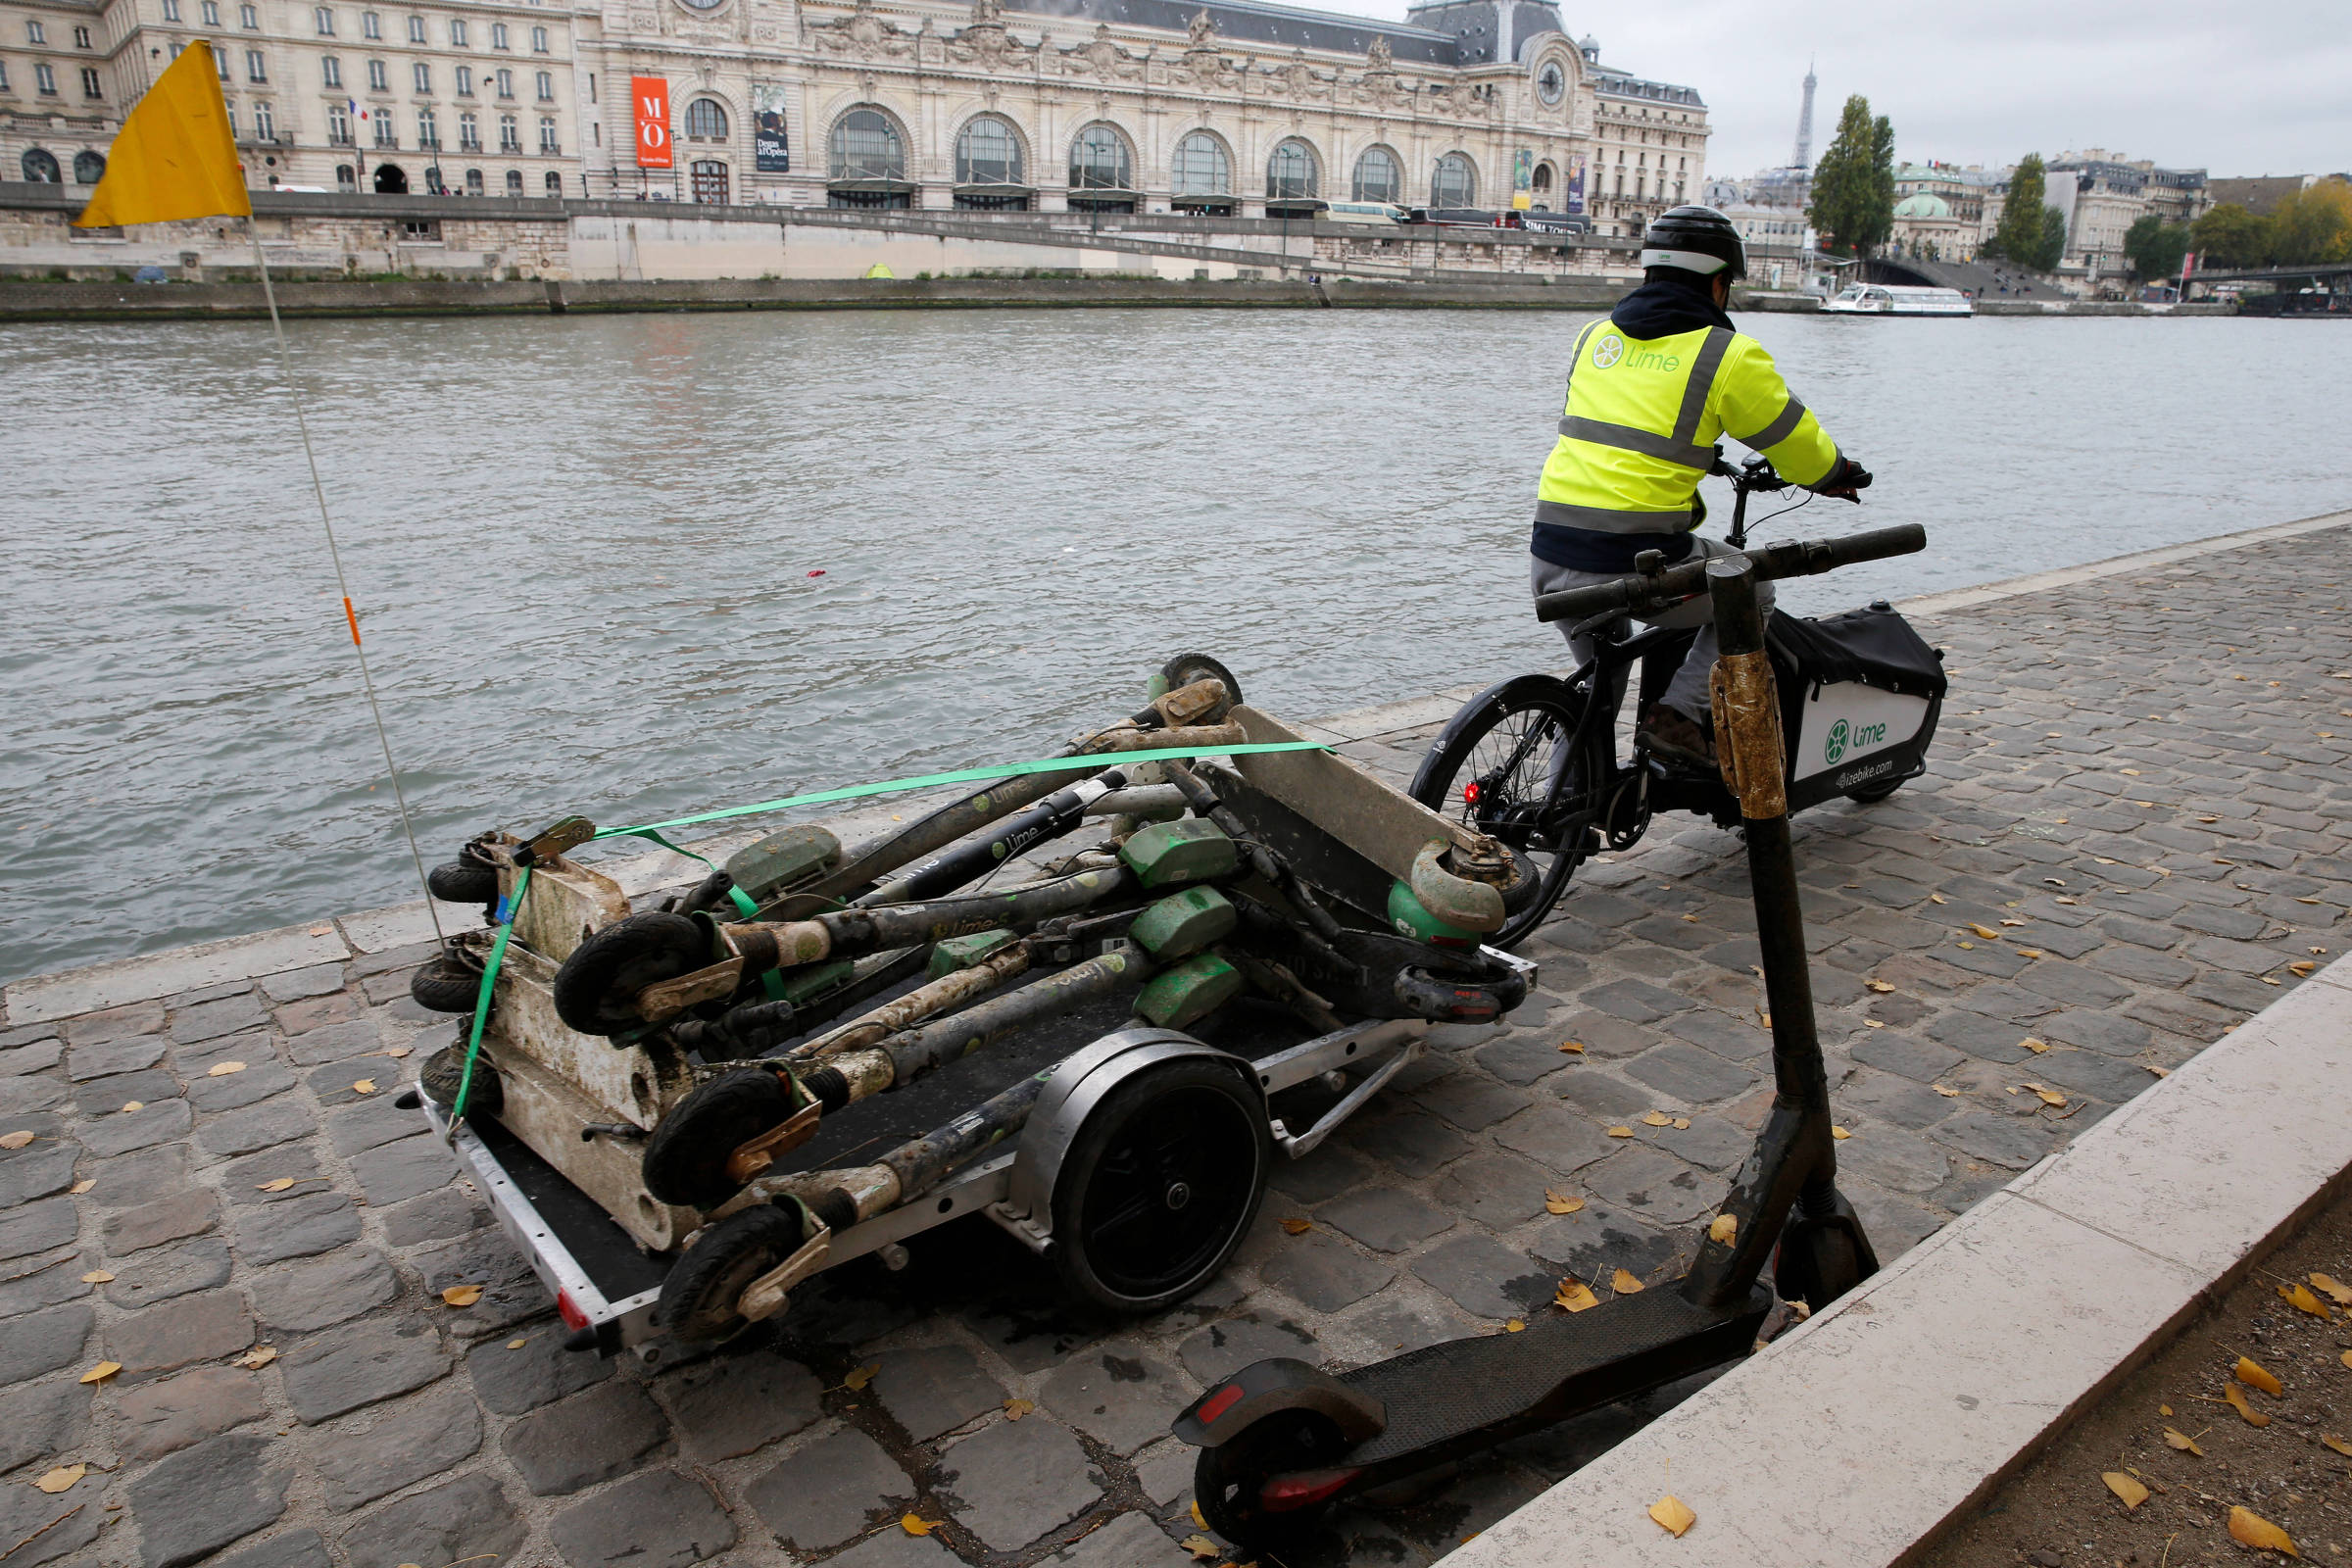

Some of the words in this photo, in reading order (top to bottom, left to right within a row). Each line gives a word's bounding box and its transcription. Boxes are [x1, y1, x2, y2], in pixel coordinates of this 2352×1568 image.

[643, 97, 662, 119] M
[758, 138, 779, 149] Degas
[1625, 345, 1680, 372] Lime
[1853, 722, 1886, 748] Lime
[1005, 826, 1039, 853] Lime
